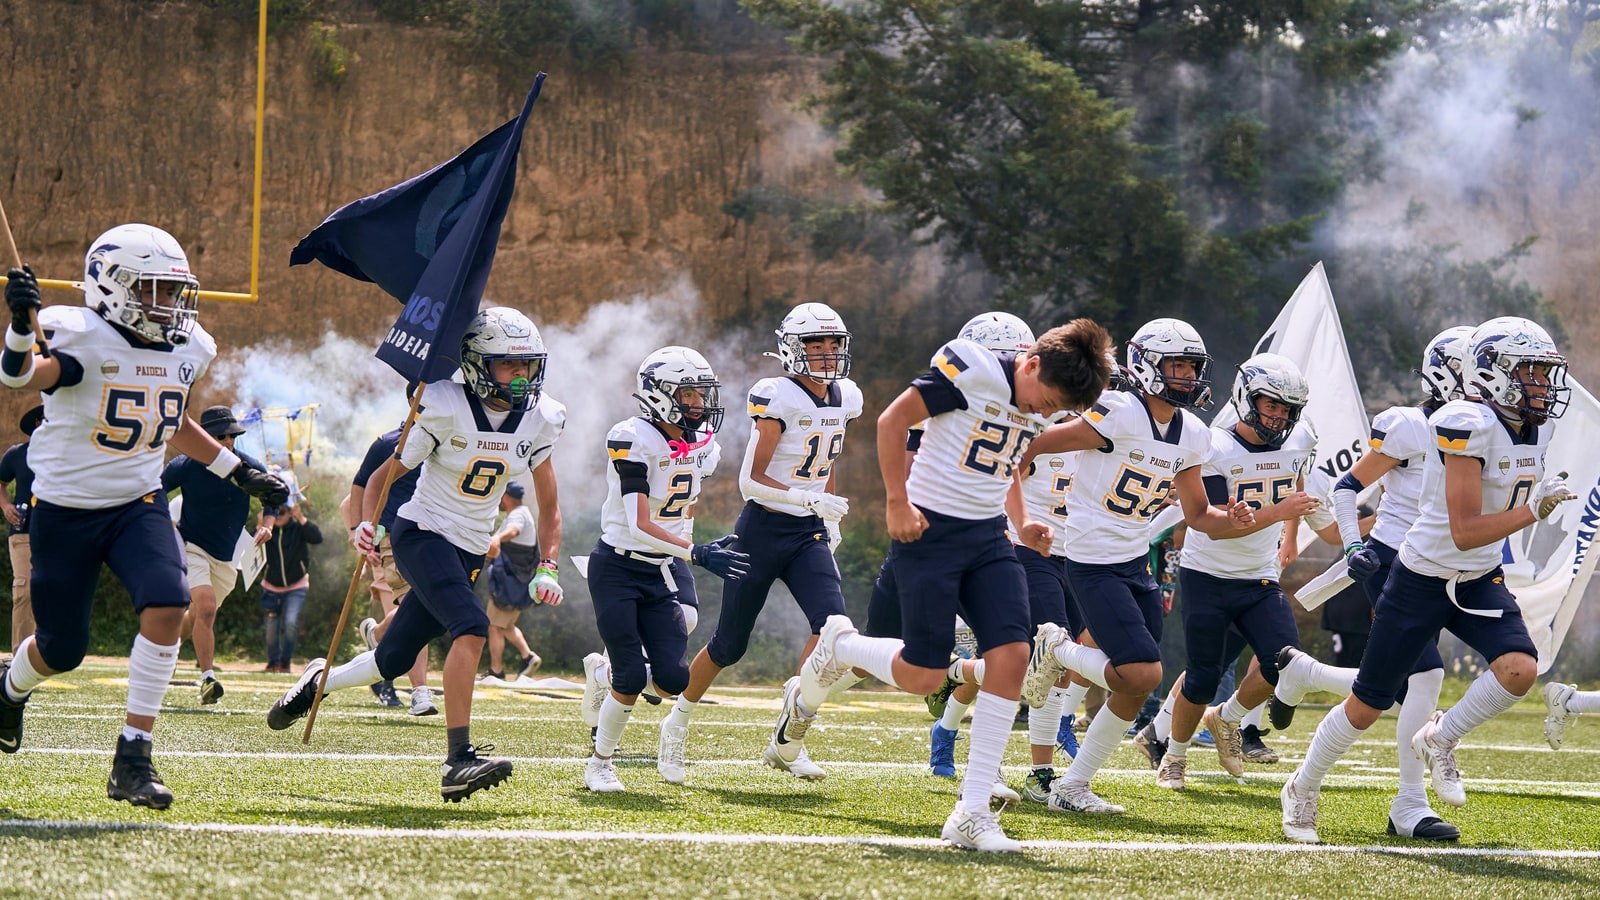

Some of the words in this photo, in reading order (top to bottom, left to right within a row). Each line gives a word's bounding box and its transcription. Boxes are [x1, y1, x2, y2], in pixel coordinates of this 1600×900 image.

[136, 366, 168, 377] PAIDEIA
[90, 383, 188, 456] 58
[477, 440, 509, 451] PAIDEIA
[791, 429, 845, 481] 19
[1256, 462, 1281, 471] PAIDEIA
[1516, 457, 1536, 468] PAIDEIA
[655, 469, 695, 521] 2
